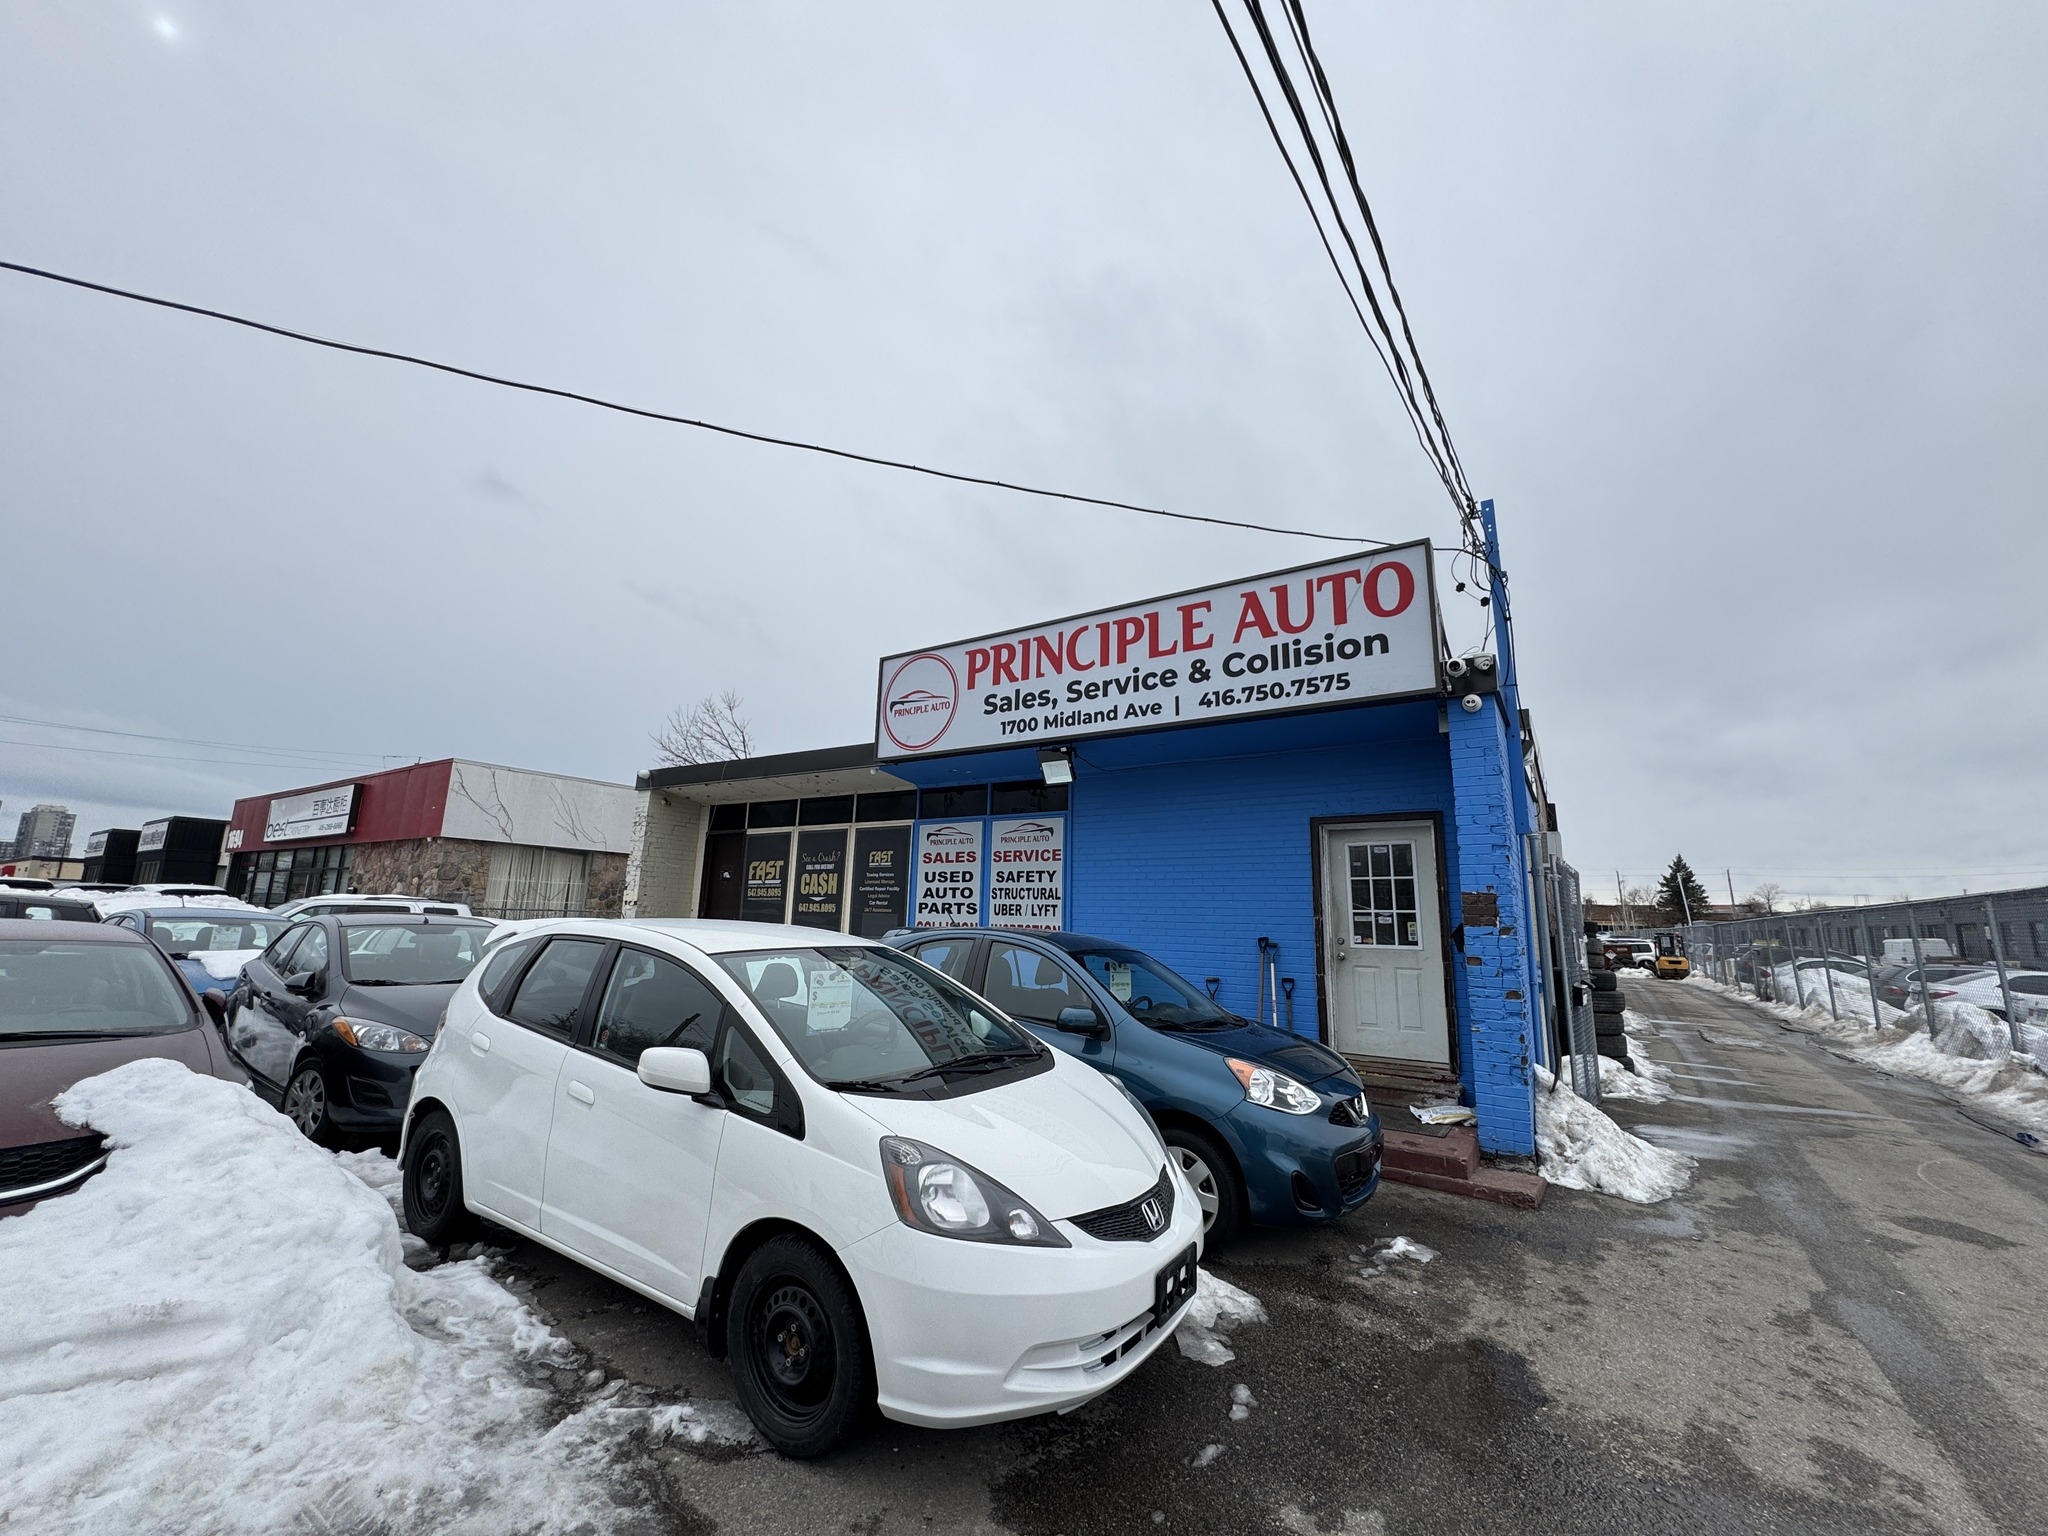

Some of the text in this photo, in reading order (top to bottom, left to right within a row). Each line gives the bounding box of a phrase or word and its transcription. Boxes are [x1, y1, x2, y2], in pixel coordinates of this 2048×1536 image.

[965, 561, 1415, 690] PRINCIPLE AUTO
[983, 633, 1389, 715] Sales, Service & Collision
[894, 701, 951, 718] PRINCIPLE AUTO
[1001, 717, 1038, 735] 1700
[1044, 705, 1118, 730] Midland
[1124, 702, 1163, 719] Ave
[1199, 672, 1350, 708] 416.750.7575
[266, 818, 289, 839] best
[930, 837, 974, 845] PRINCIPLE AUTO
[1001, 834, 1050, 843] PRINCIPLE AUTO
[869, 851, 893, 864] FAST
[922, 851, 977, 864] SALES
[993, 849, 1062, 863] SERVICE
[748, 860, 784, 882] FAST
[924, 871, 974, 883] USED
[996, 870, 1057, 883] SAFETY
[800, 872, 838, 896] CA$H
[922, 887, 974, 899] AUTO
[991, 887, 1061, 900] STRUCTURAL
[798, 903, 836, 912] 647.945.8095
[918, 902, 978, 915] PARTS
[993, 904, 1022, 916] UBER
[1031, 904, 1058, 917] LYFT
